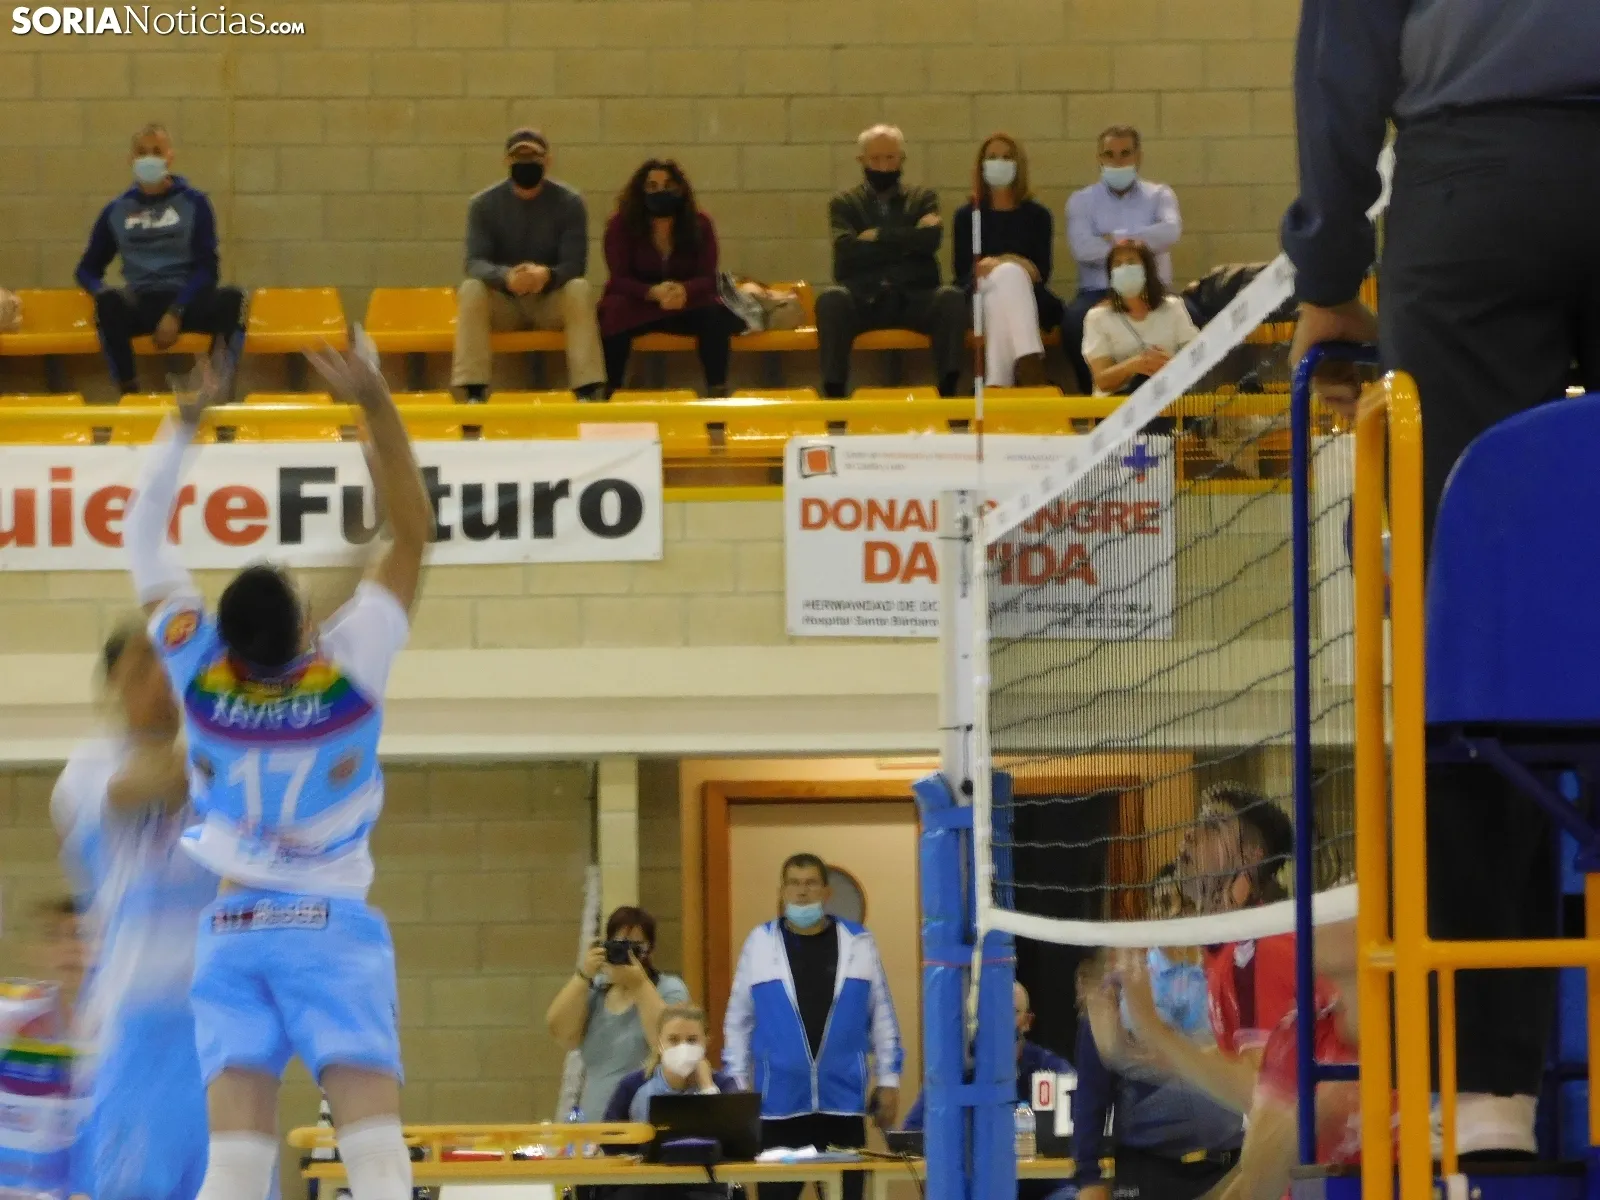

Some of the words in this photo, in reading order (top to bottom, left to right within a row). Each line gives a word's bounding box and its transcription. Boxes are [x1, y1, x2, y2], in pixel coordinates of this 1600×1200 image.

[863, 541, 939, 583] DA
[986, 543, 1098, 586] IDA
[228, 749, 318, 827] 17
